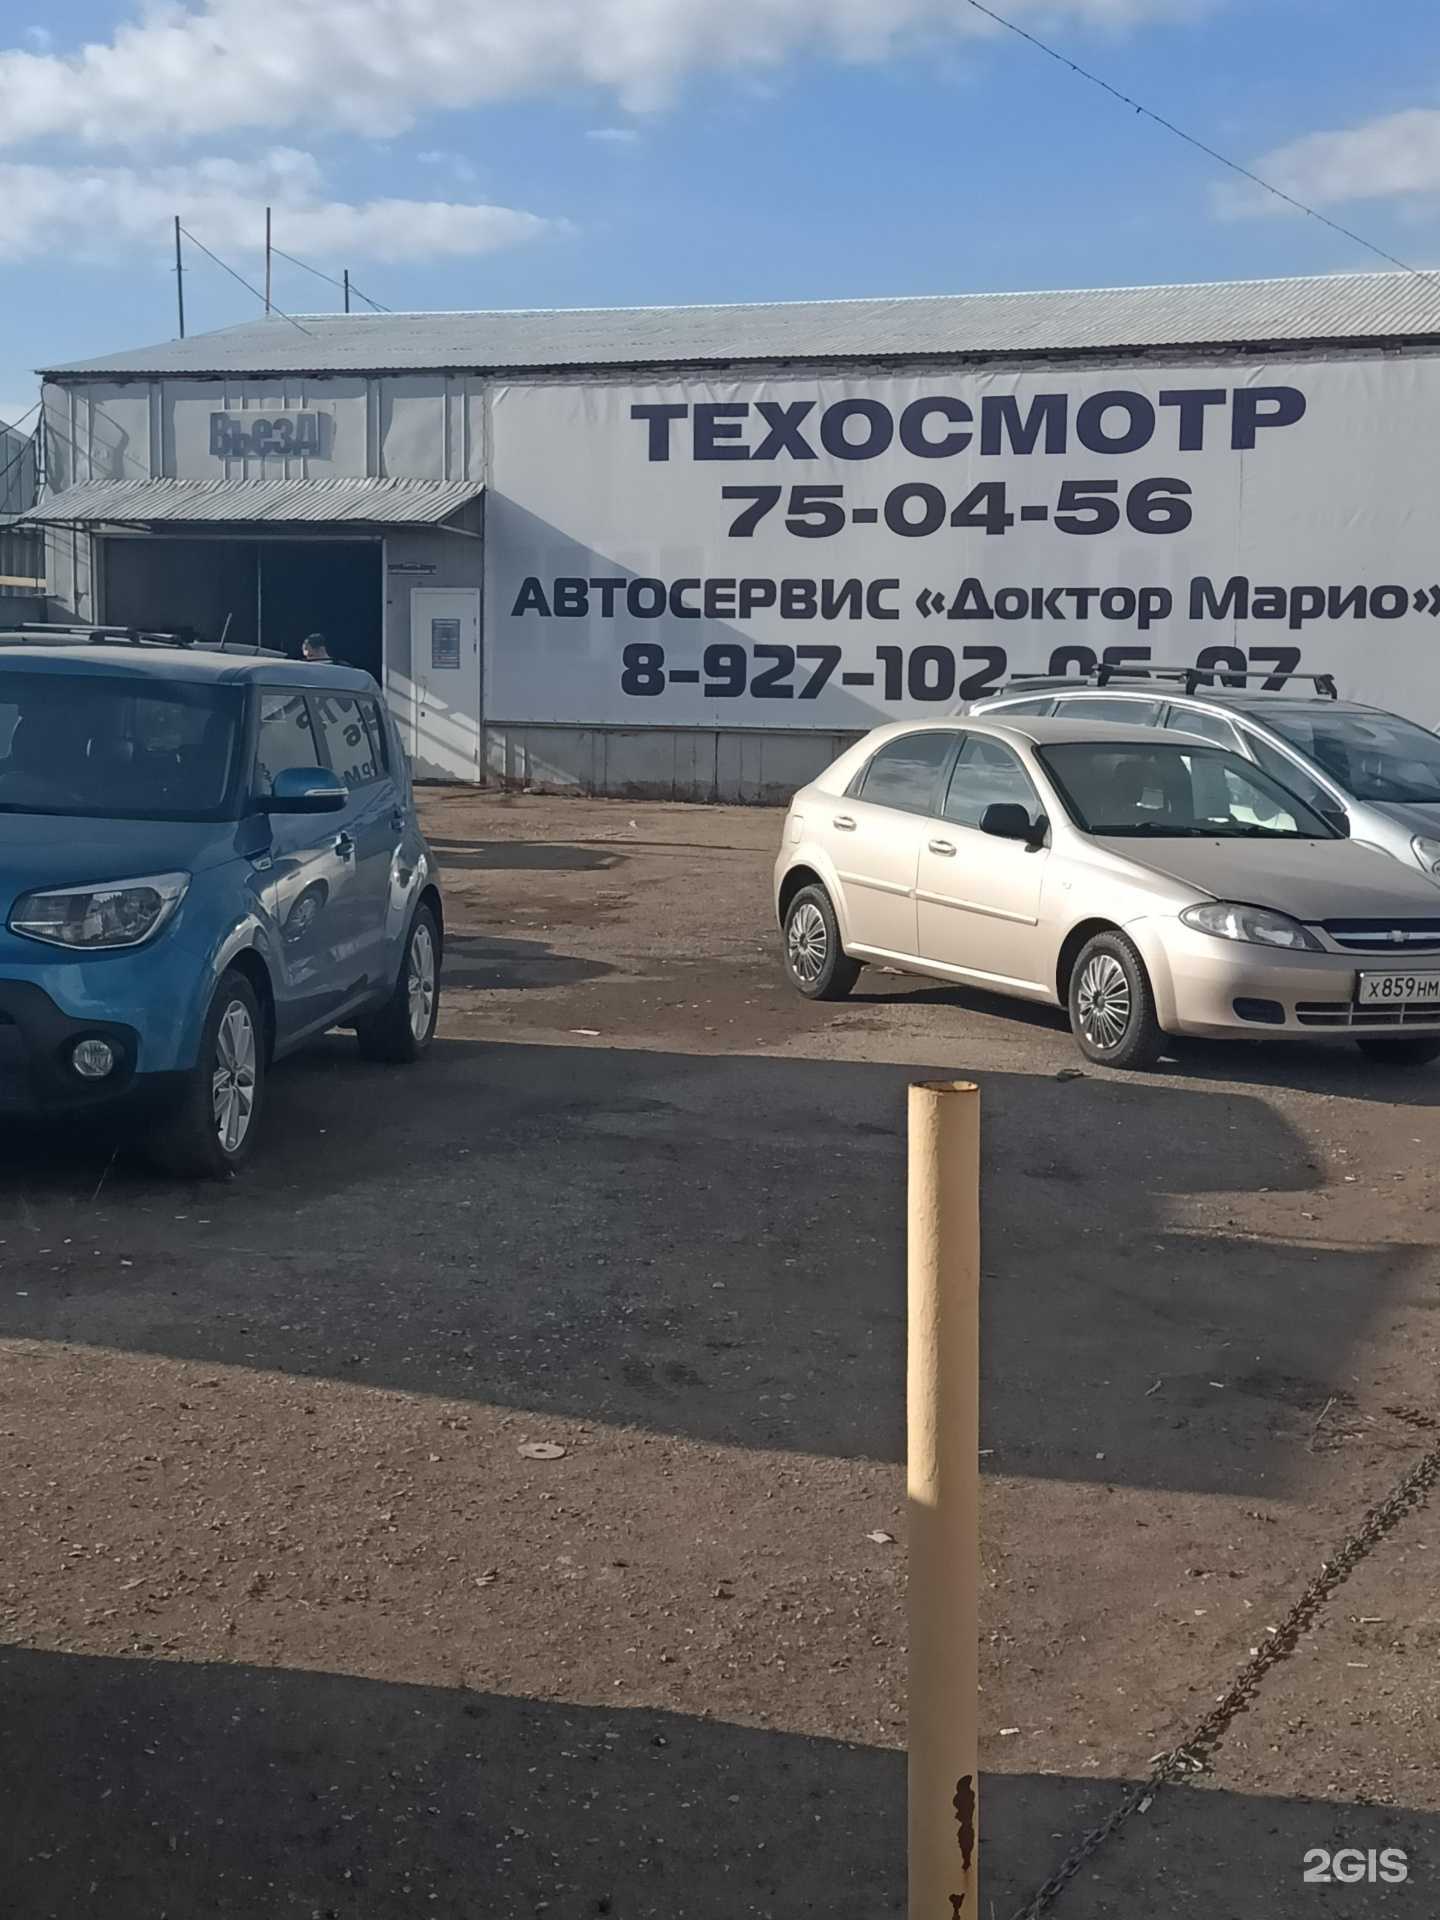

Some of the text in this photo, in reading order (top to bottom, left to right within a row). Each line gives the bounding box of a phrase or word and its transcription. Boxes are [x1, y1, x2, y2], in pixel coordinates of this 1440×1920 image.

[631, 387, 1306, 462] ТЕХОСМОТР
[722, 477, 1193, 538] 75-04-56
[511, 576, 1440, 630] АВТОСЕРВИС «Доктор Марио»
